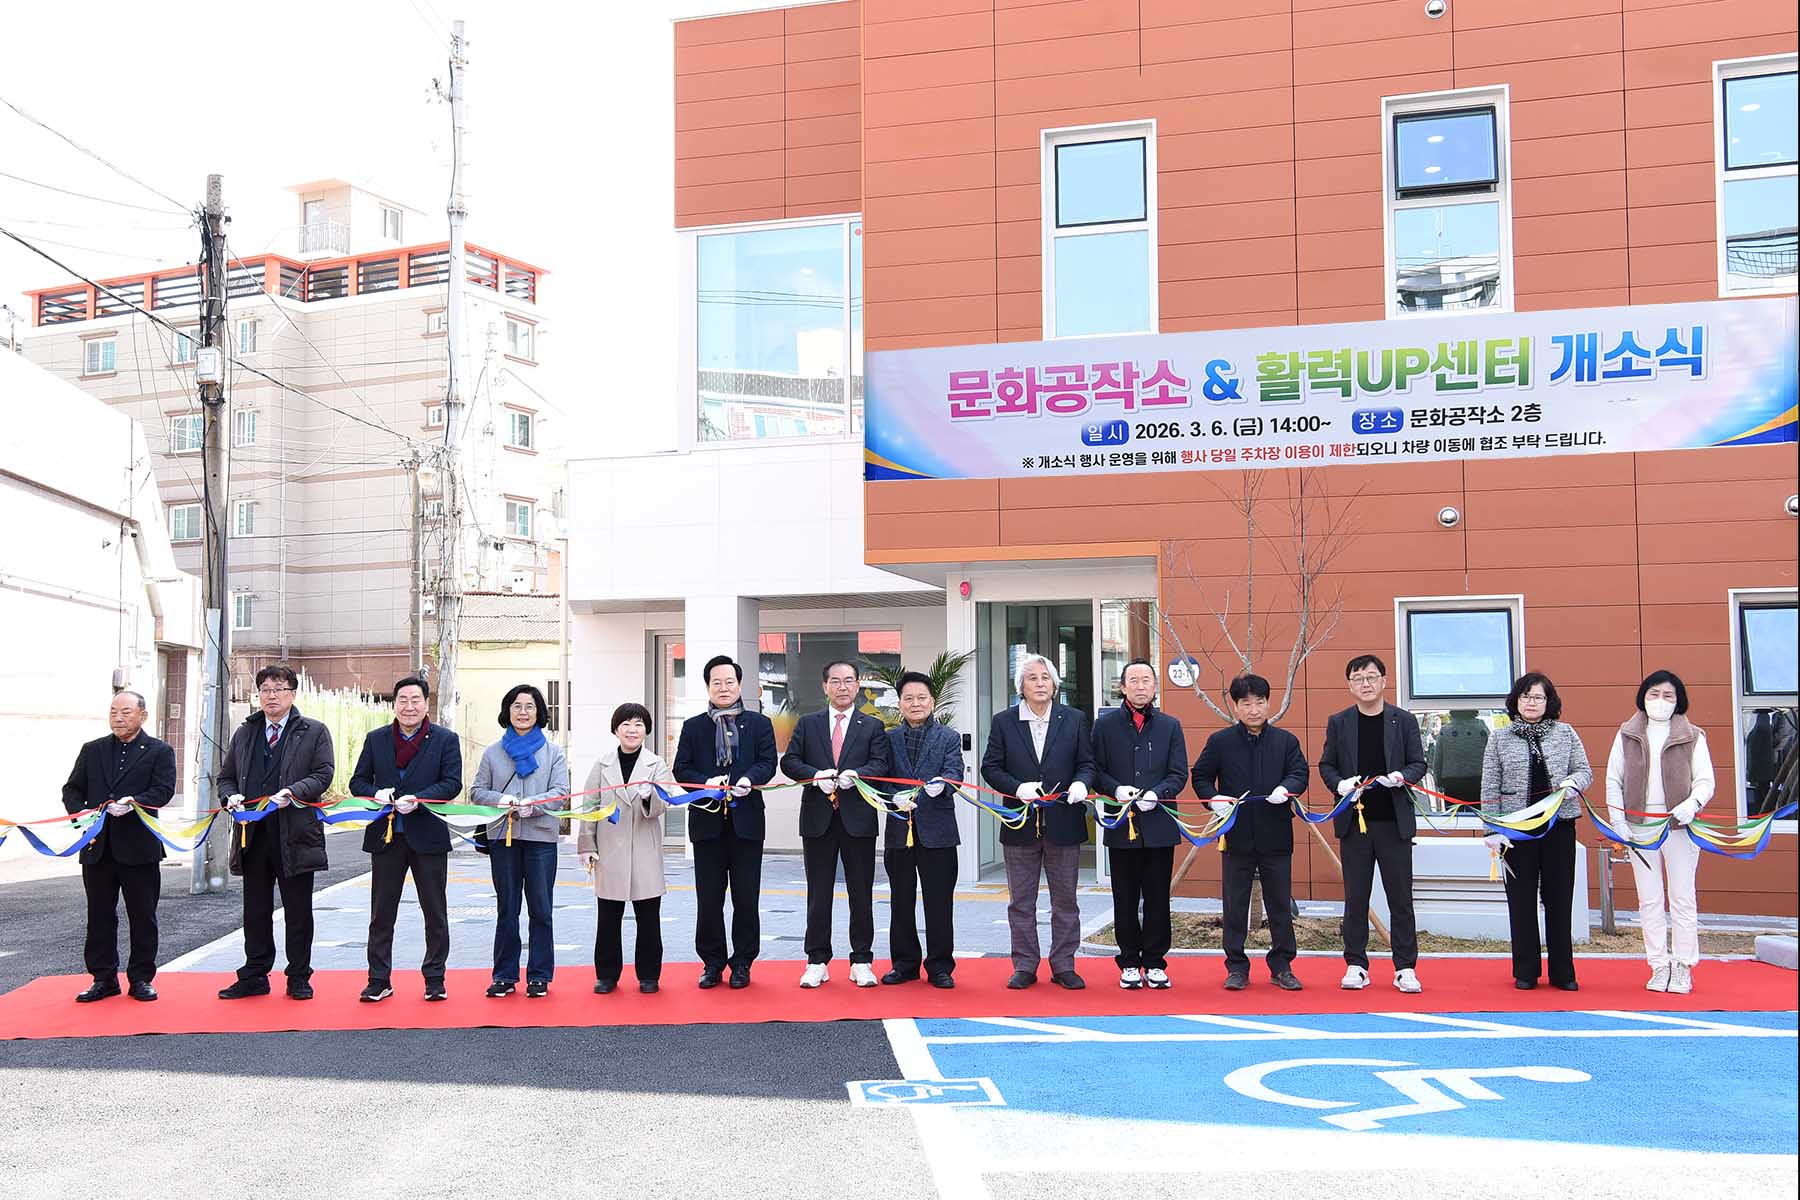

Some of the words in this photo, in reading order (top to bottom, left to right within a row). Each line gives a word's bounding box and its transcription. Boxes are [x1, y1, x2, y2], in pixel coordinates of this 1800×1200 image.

[947, 360, 1188, 418] 문화공작소
[1202, 359, 1243, 402] &
[1255, 336, 1530, 402] 활력UP센터
[1550, 326, 1703, 382] 개소식
[1135, 422, 1185, 440] 2026.
[1190, 421, 1206, 437] 3.
[1211, 420, 1228, 436] 6.
[1233, 417, 1264, 437] (금)
[1270, 415, 1332, 434] 14:00~
[1410, 405, 1505, 428] 문화공작소
[1511, 403, 1542, 423] 2층
[1038, 454, 1076, 469] 개소식
[1079, 453, 1106, 468] 행사
[1109, 451, 1148, 467] 운영을
[1151, 450, 1177, 465] 위해
[1180, 449, 1207, 464] 행사
[1211, 448, 1237, 463] 당일
[1240, 446, 1281, 461] 주차장
[1285, 444, 1325, 460] 이용이
[1402, 439, 1431, 454] 차량
[1434, 437, 1475, 453] 이동에
[1480, 435, 1508, 451] 협조
[1512, 434, 1541, 449] 부탁
[1544, 431, 1607, 447] 드립니다.
